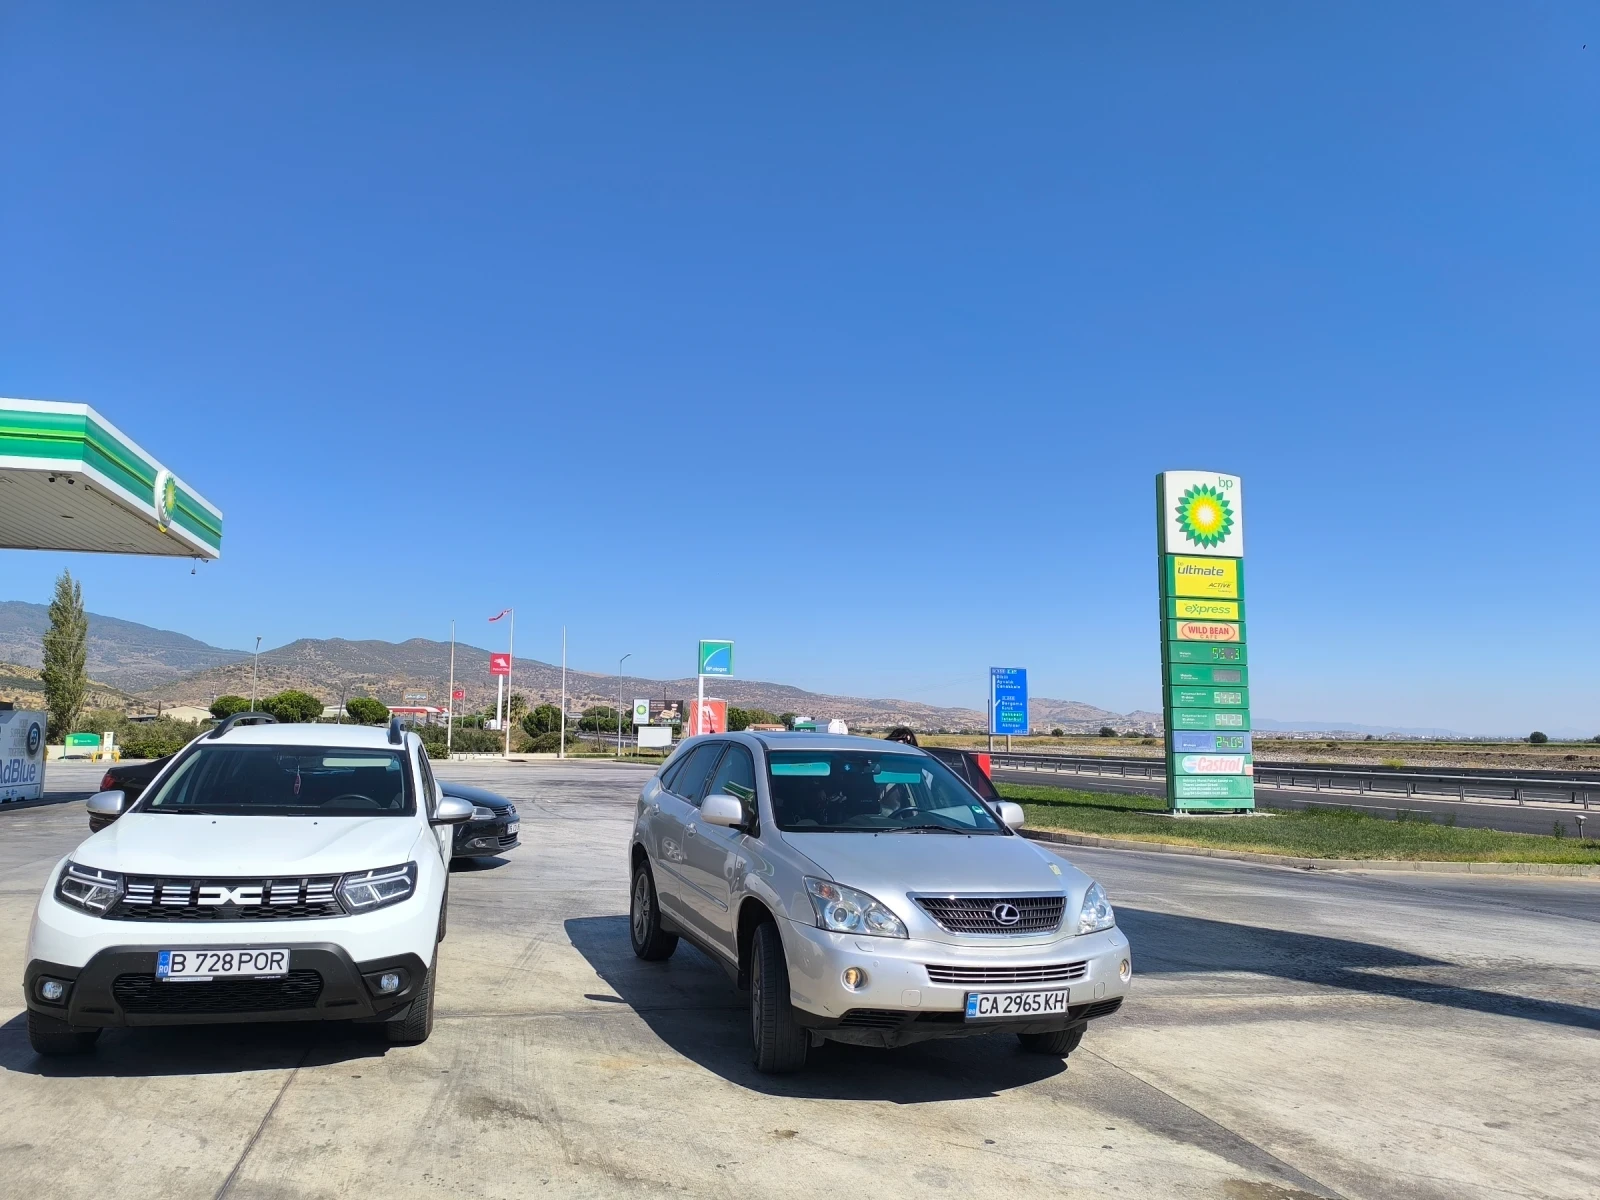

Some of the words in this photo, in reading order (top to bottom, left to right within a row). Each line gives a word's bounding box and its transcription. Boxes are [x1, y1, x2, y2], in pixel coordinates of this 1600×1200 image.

[1218, 476, 1233, 490] bp
[1177, 564, 1224, 576] ultimate
[1184, 603, 1231, 615] express
[1187, 625, 1208, 635] WILD
[1209, 627, 1230, 635] BEAN
[1198, 757, 1241, 772] Castrol
[171, 953, 187, 973] B
[195, 952, 234, 972] 728
[238, 951, 285, 971] POR
[158, 965, 168, 973] RO
[979, 996, 999, 1014] CA
[1003, 994, 1041, 1013] 2965
[1044, 993, 1065, 1011] KH
